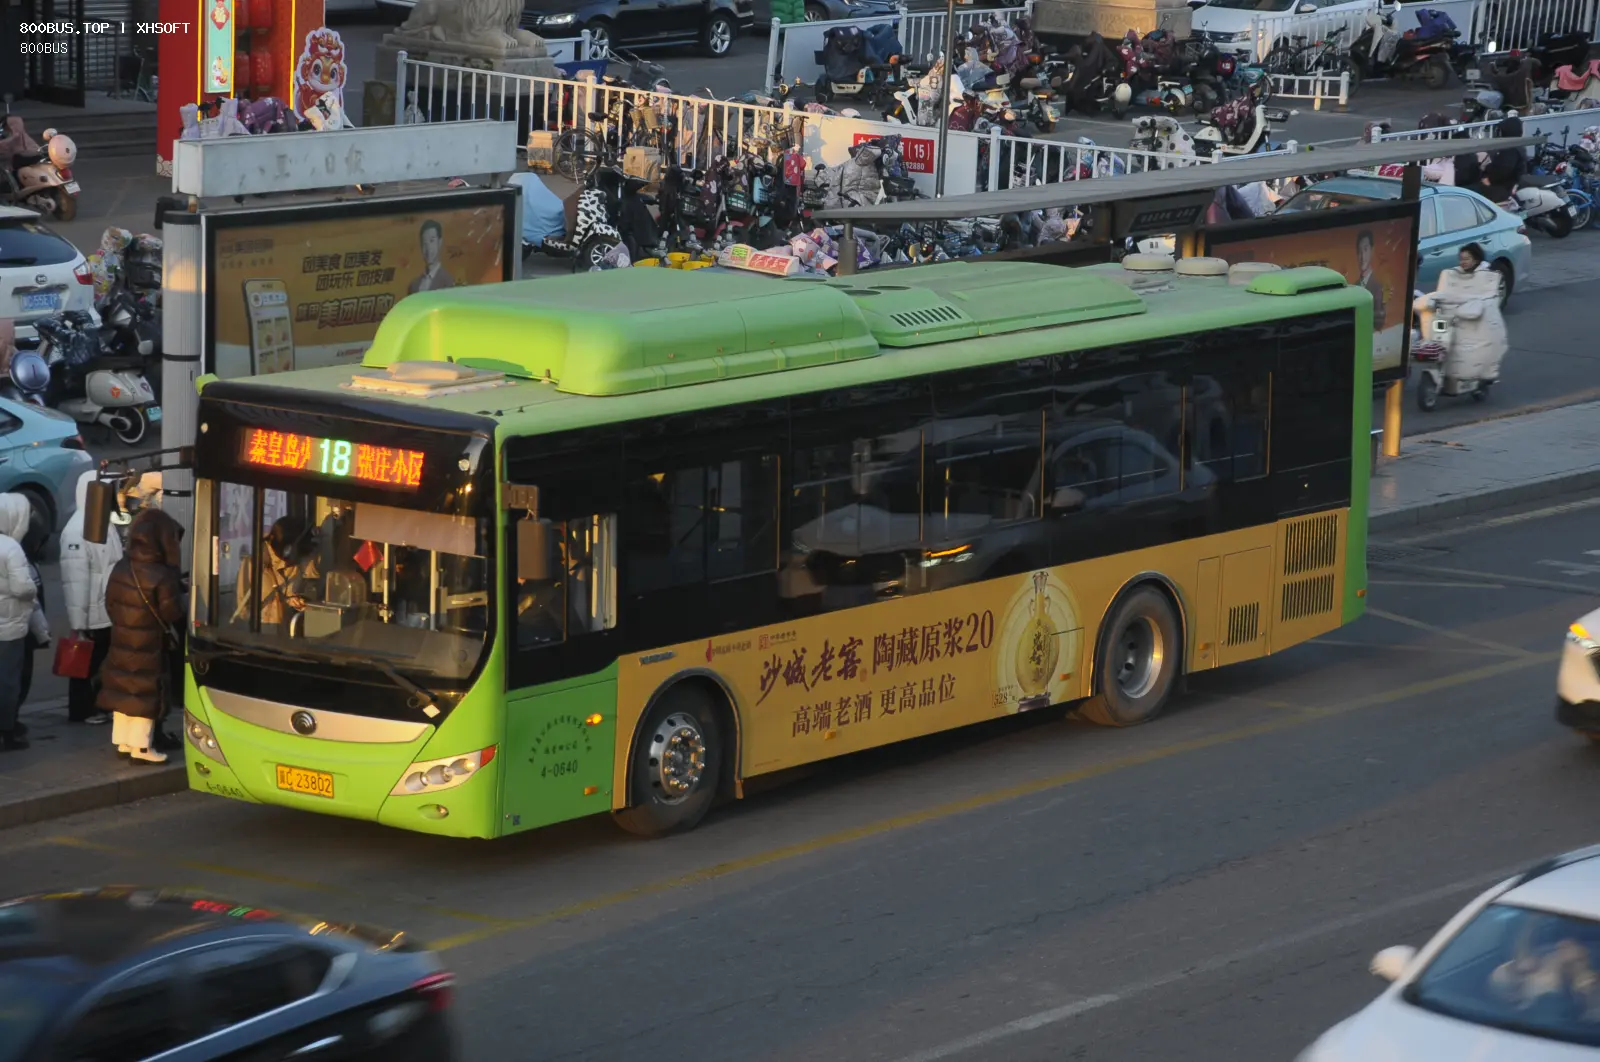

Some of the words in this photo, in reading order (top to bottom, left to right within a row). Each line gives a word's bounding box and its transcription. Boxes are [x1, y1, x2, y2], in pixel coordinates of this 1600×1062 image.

[319, 438, 352, 477] 18
[791, 687, 872, 738] 高端老酒
[878, 673, 956, 719] 更高品位
